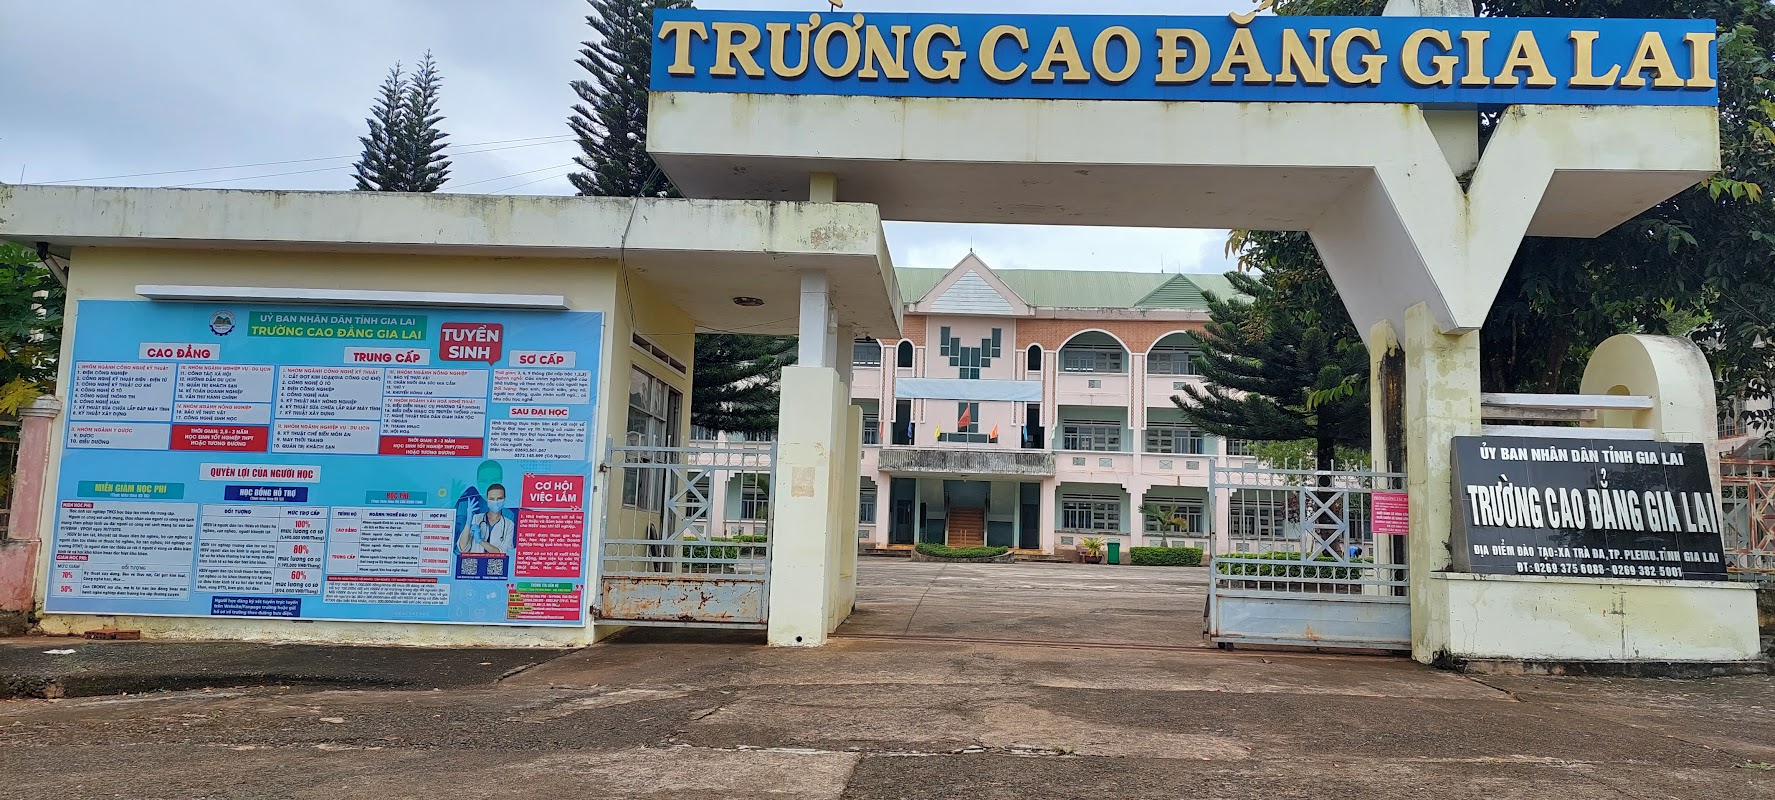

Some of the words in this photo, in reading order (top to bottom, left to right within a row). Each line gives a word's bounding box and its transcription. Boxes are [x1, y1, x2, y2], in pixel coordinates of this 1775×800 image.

[658, 0, 967, 80] TRƯỜNG
[979, 25, 1141, 81] CAO
[1401, 28, 1557, 87] GIA
[1567, 30, 1717, 88] LAI
[300, 314, 328, 324] NHÂN
[330, 315, 352, 324] DÂN
[355, 315, 378, 324] TỈNH
[252, 324, 303, 336] TRƯỜNG
[307, 328, 334, 337] CAO
[337, 325, 373, 338] ĐẲNG
[377, 330, 398, 339] GIA
[402, 330, 421, 339] LAI
[442, 325, 499, 342] TUYỂN
[147, 348, 173, 358] CAO
[177, 344, 211, 358] ĐẲNG
[354, 352, 392, 363] TRUNG
[395, 350, 421, 363] CẤP
[448, 346, 490, 359] SINH
[520, 354, 536, 364] SƠ
[540, 353, 564, 365] CẤP
[1480, 442, 1496, 460] ỦY
[1500, 447, 1528, 461] BAN
[1531, 446, 1568, 462] NHÂN
[1570, 447, 1599, 463] DÂN
[1602, 446, 1633, 464] TỈNH
[1636, 451, 1659, 465] GIA
[1661, 452, 1684, 466] LAI
[210, 466, 235, 477] QUYỀN
[238, 468, 250, 478] LỢI
[252, 467, 267, 478] CỦA
[270, 468, 294, 478] NGƯỜI
[297, 470, 313, 480] HỌC
[535, 481, 552, 490] CƠ
[530, 492, 553, 504] VIỆC
[1467, 474, 1544, 528] TRƯỜNG
[1545, 487, 1586, 530] CAO
[1588, 468, 1644, 532] ĐẲNG
[1644, 490, 1682, 532] GIA
[1680, 492, 1718, 533] LAI
[294, 545, 309, 554] 80%
[1474, 545, 1489, 557] ĐỊA
[1492, 539, 1515, 556] ĐIỂM
[1517, 544, 1535, 556] ĐÀO
[1573, 546, 1591, 558] TRÀ
[1683, 552, 1701, 562] GIA
[1702, 552, 1719, 563] LAI
[291, 571, 306, 580] 60%
[1560, 563, 1578, 574] 375
[1580, 564, 1605, 574] 6088
[1612, 565, 1636, 575] 0269
[1638, 566, 1656, 576] 382
[1659, 566, 1682, 577] 5001
